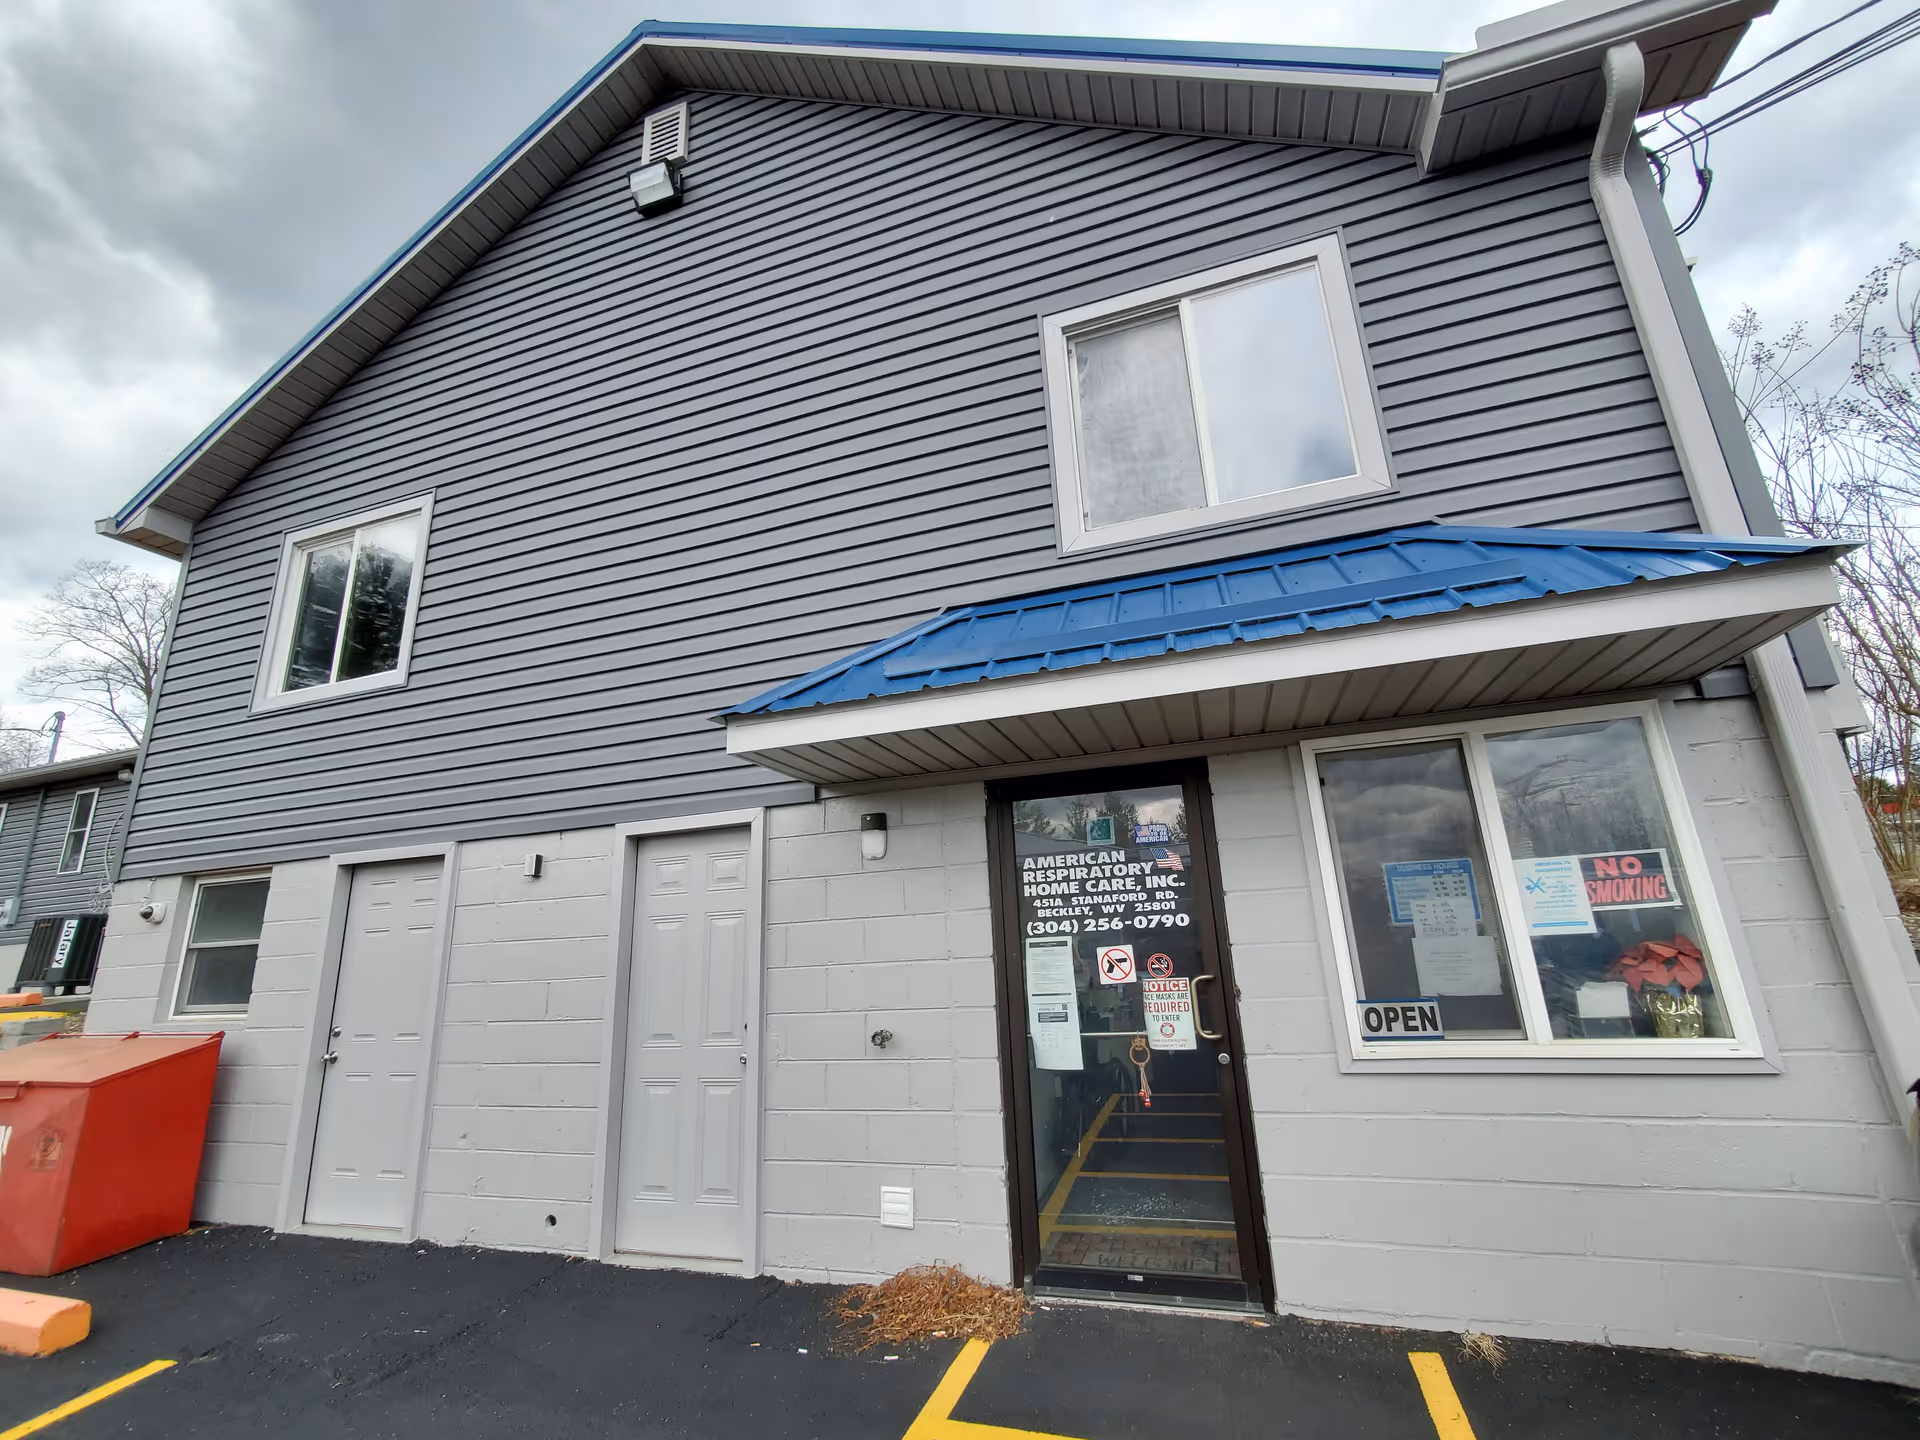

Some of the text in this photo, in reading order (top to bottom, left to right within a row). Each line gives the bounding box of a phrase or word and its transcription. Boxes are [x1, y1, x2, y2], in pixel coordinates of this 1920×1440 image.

[1023, 850, 1125, 869] AMERICAN
[1593, 856, 1642, 877] NO
[1023, 861, 1154, 883] RESPIRATORY
[1024, 874, 1186, 897] HOME CARE, INC.
[1585, 875, 1667, 904] SMOKING
[1032, 890, 1179, 908] 451A STANAFORD RD.
[1037, 901, 1176, 918] BECKLEY, WV 25801
[1026, 913, 1190, 936] (304) 256-0790
[54, 921, 76, 966] Jafary
[1143, 981, 1187, 991] NOTICE
[1177, 992, 1189, 1000] ARE
[1144, 1001, 1189, 1013] REQUIRED
[1152, 1014, 1181, 1022] TO ENTER
[1364, 1006, 1439, 1033] OPEN
